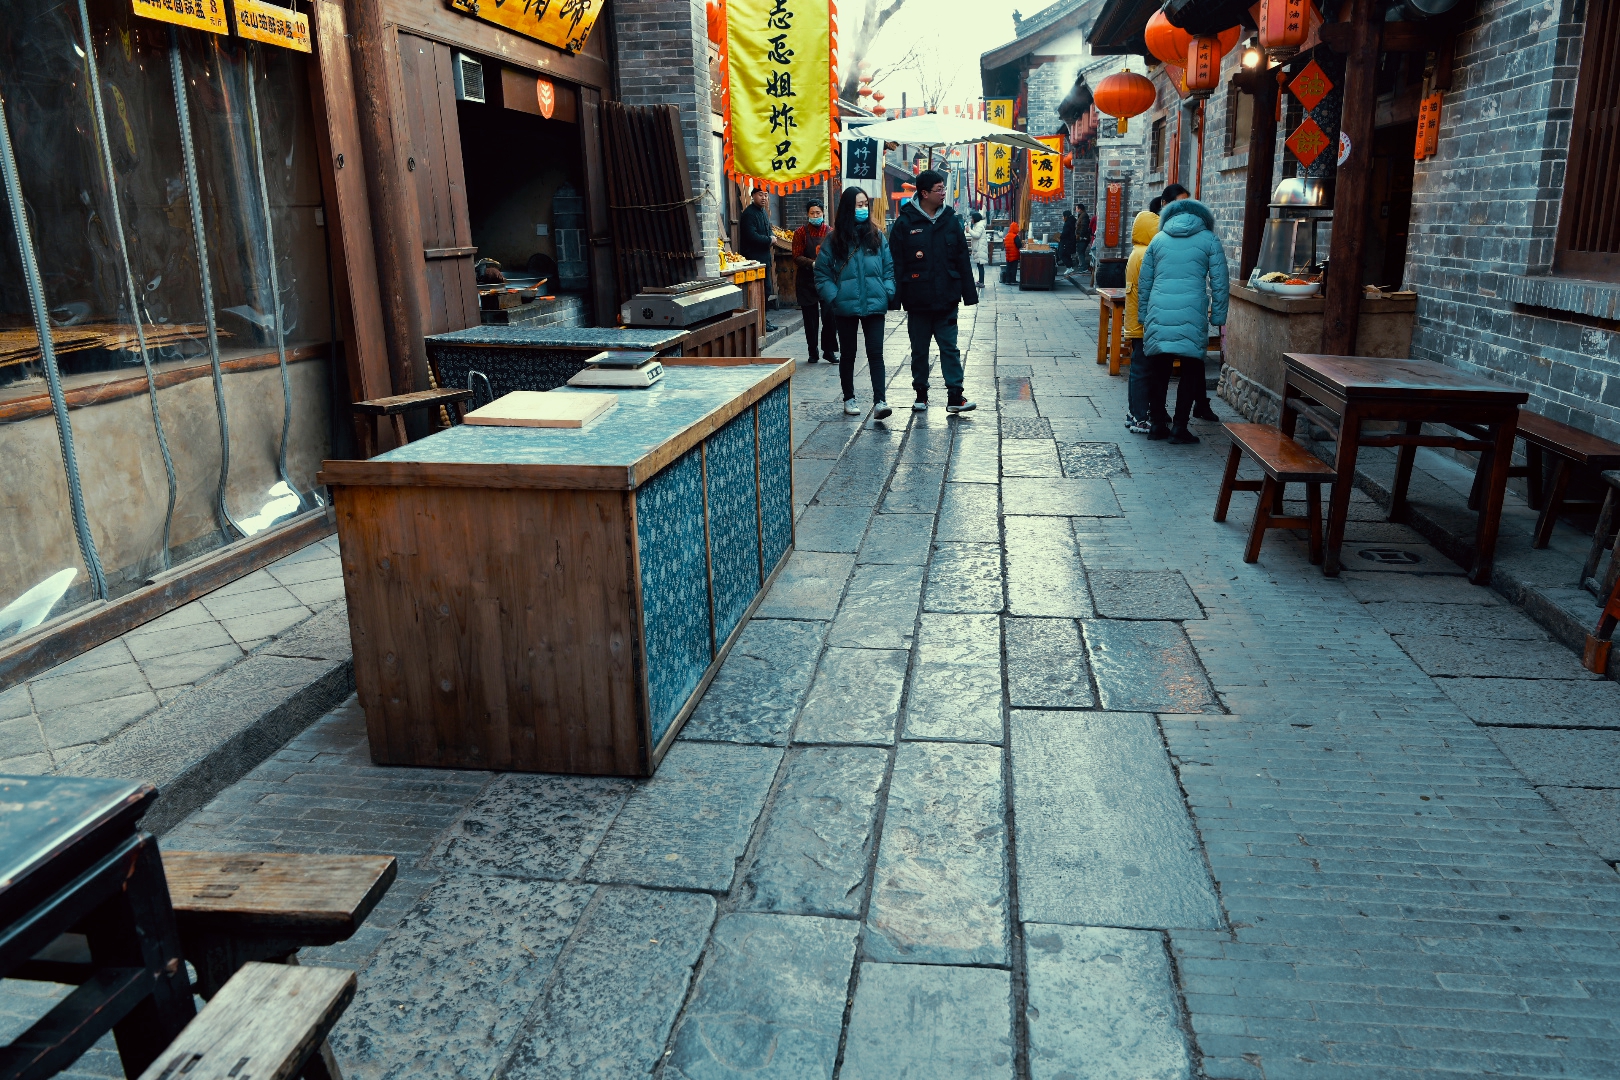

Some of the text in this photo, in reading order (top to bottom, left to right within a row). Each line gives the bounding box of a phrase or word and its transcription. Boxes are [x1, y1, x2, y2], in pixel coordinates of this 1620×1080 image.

[209, 0, 218, 13] 8
[295, 21, 306, 34] 10
[1299, 72, 1325, 98] 油
